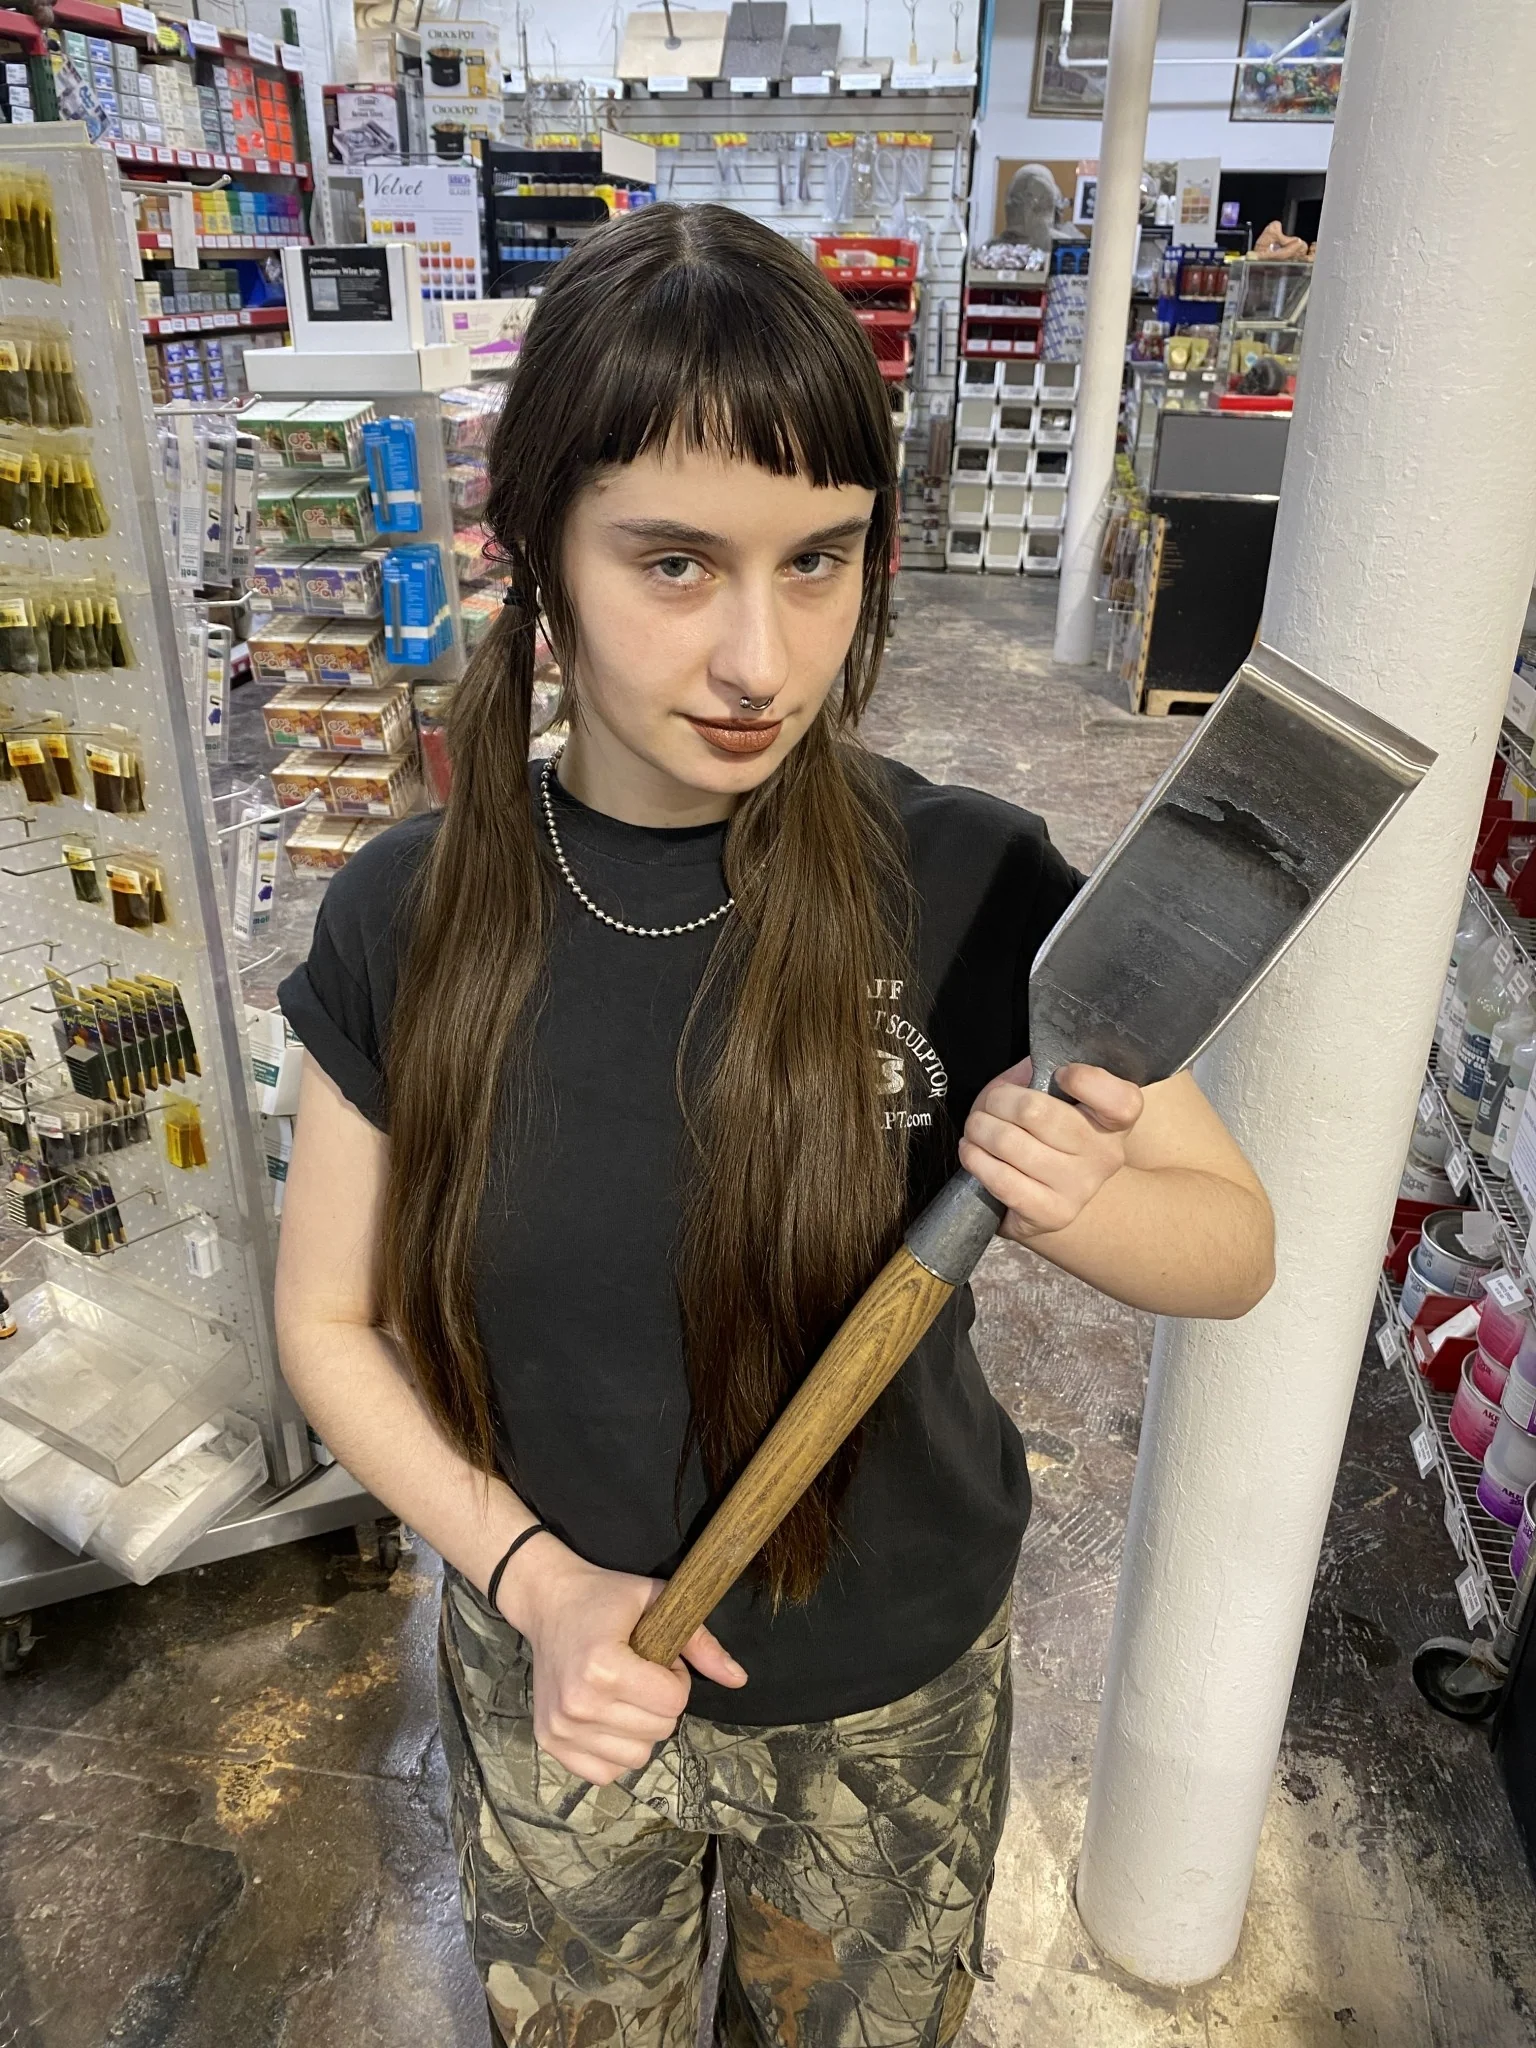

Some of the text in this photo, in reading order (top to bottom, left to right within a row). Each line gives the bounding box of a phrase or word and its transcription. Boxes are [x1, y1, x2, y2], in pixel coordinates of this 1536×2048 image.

[368, 172, 423, 196] Velvet
[341, 266, 358, 276] Wire
[359, 266, 380, 277] Figure
[885, 1014, 948, 1099] SCULPTOR
